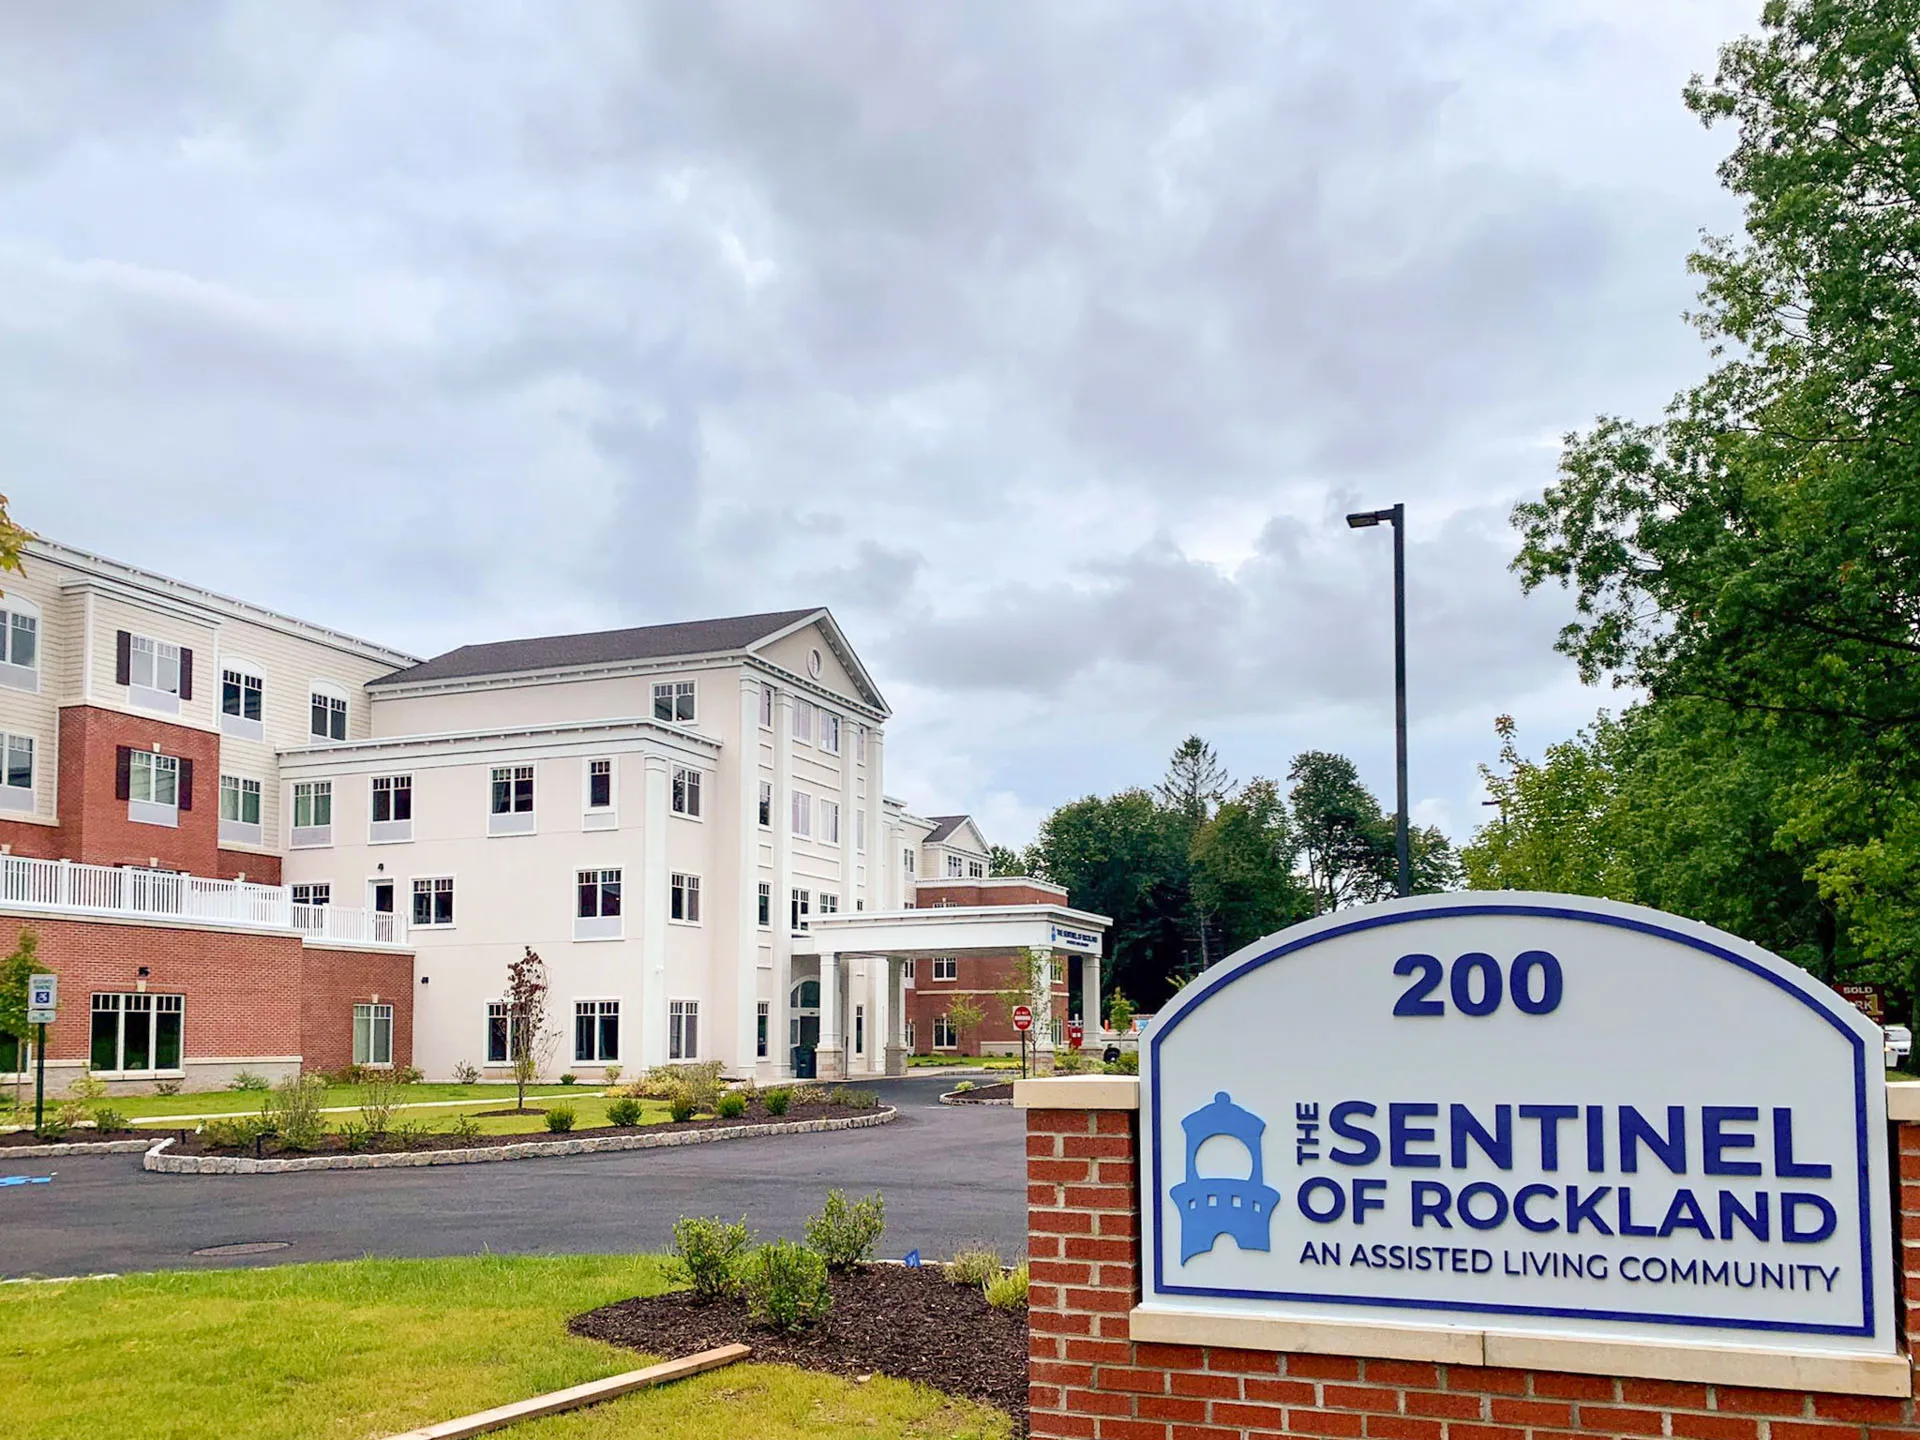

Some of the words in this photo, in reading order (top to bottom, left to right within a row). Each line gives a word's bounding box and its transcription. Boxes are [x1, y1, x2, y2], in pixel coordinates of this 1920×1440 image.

[1392, 950, 1564, 1017] 200
[1843, 986, 1873, 994] SOLD
[1296, 1102, 1319, 1165] THE
[1329, 1100, 1833, 1180] SENTINEL
[1296, 1177, 1388, 1225] OF
[1411, 1180, 1838, 1244] ROCKLAND
[1299, 1241, 1342, 1266] AN
[1350, 1244, 1494, 1274] ASSISTED
[1503, 1250, 1609, 1280] LIVING
[1618, 1256, 1841, 1293] COMMUNITY
